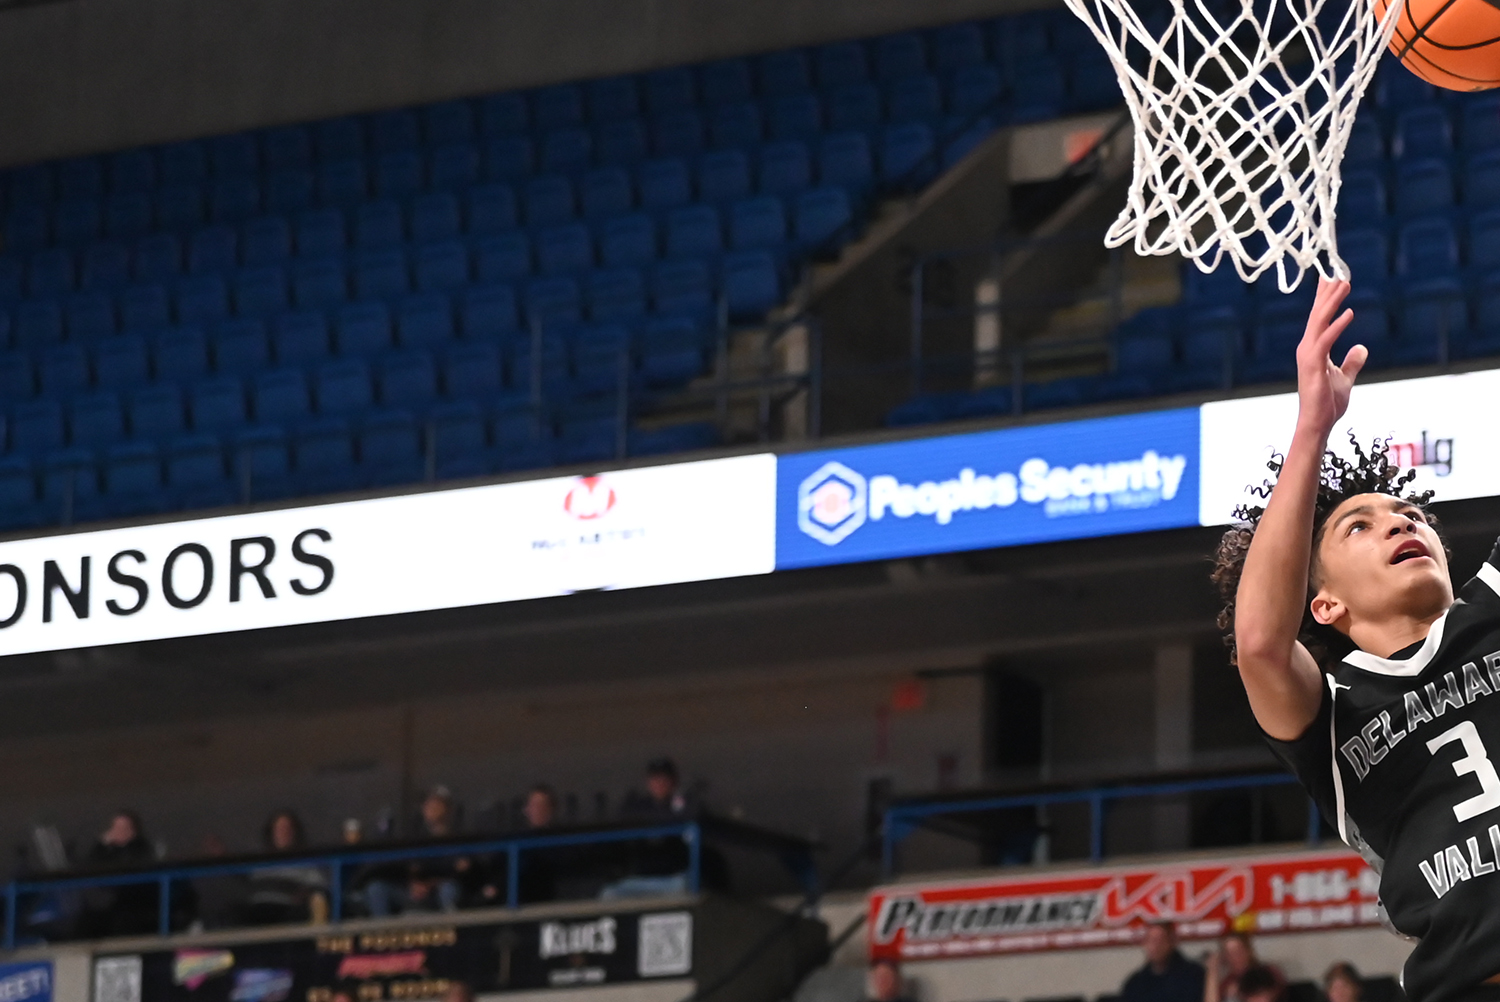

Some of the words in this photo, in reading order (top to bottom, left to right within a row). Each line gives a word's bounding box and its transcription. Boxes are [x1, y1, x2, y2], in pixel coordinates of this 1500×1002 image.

[868, 468, 1018, 526] Peoples
[1018, 449, 1187, 503] Security
[1099, 866, 1254, 926] KIA
